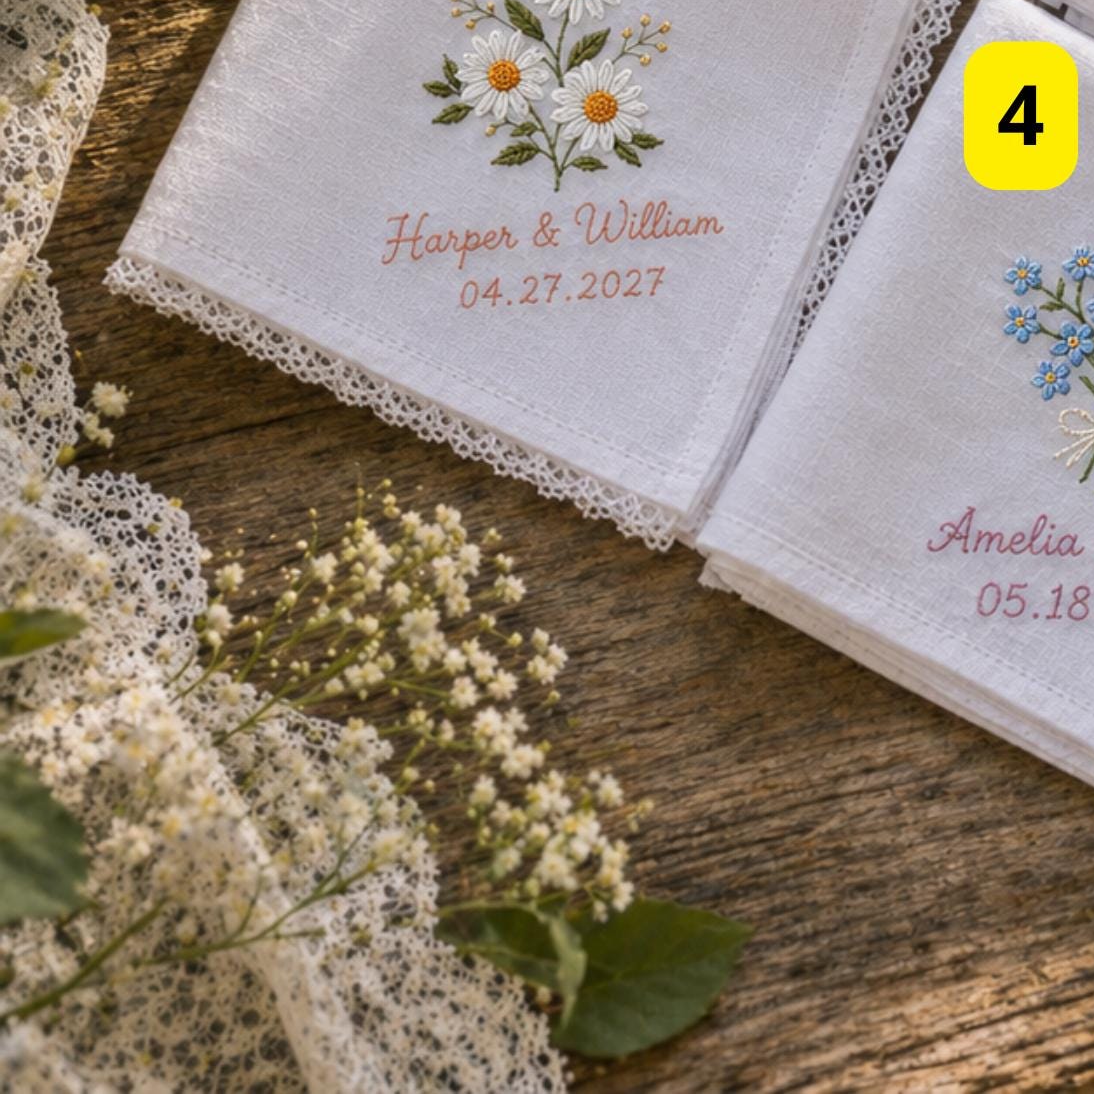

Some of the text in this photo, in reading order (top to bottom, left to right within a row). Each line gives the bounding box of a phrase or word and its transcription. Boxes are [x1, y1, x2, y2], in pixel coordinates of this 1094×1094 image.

[381, 199, 724, 270] Harper & William
[459, 266, 665, 309] 04.27.2027
[927, 506, 1085, 556] Amelia
